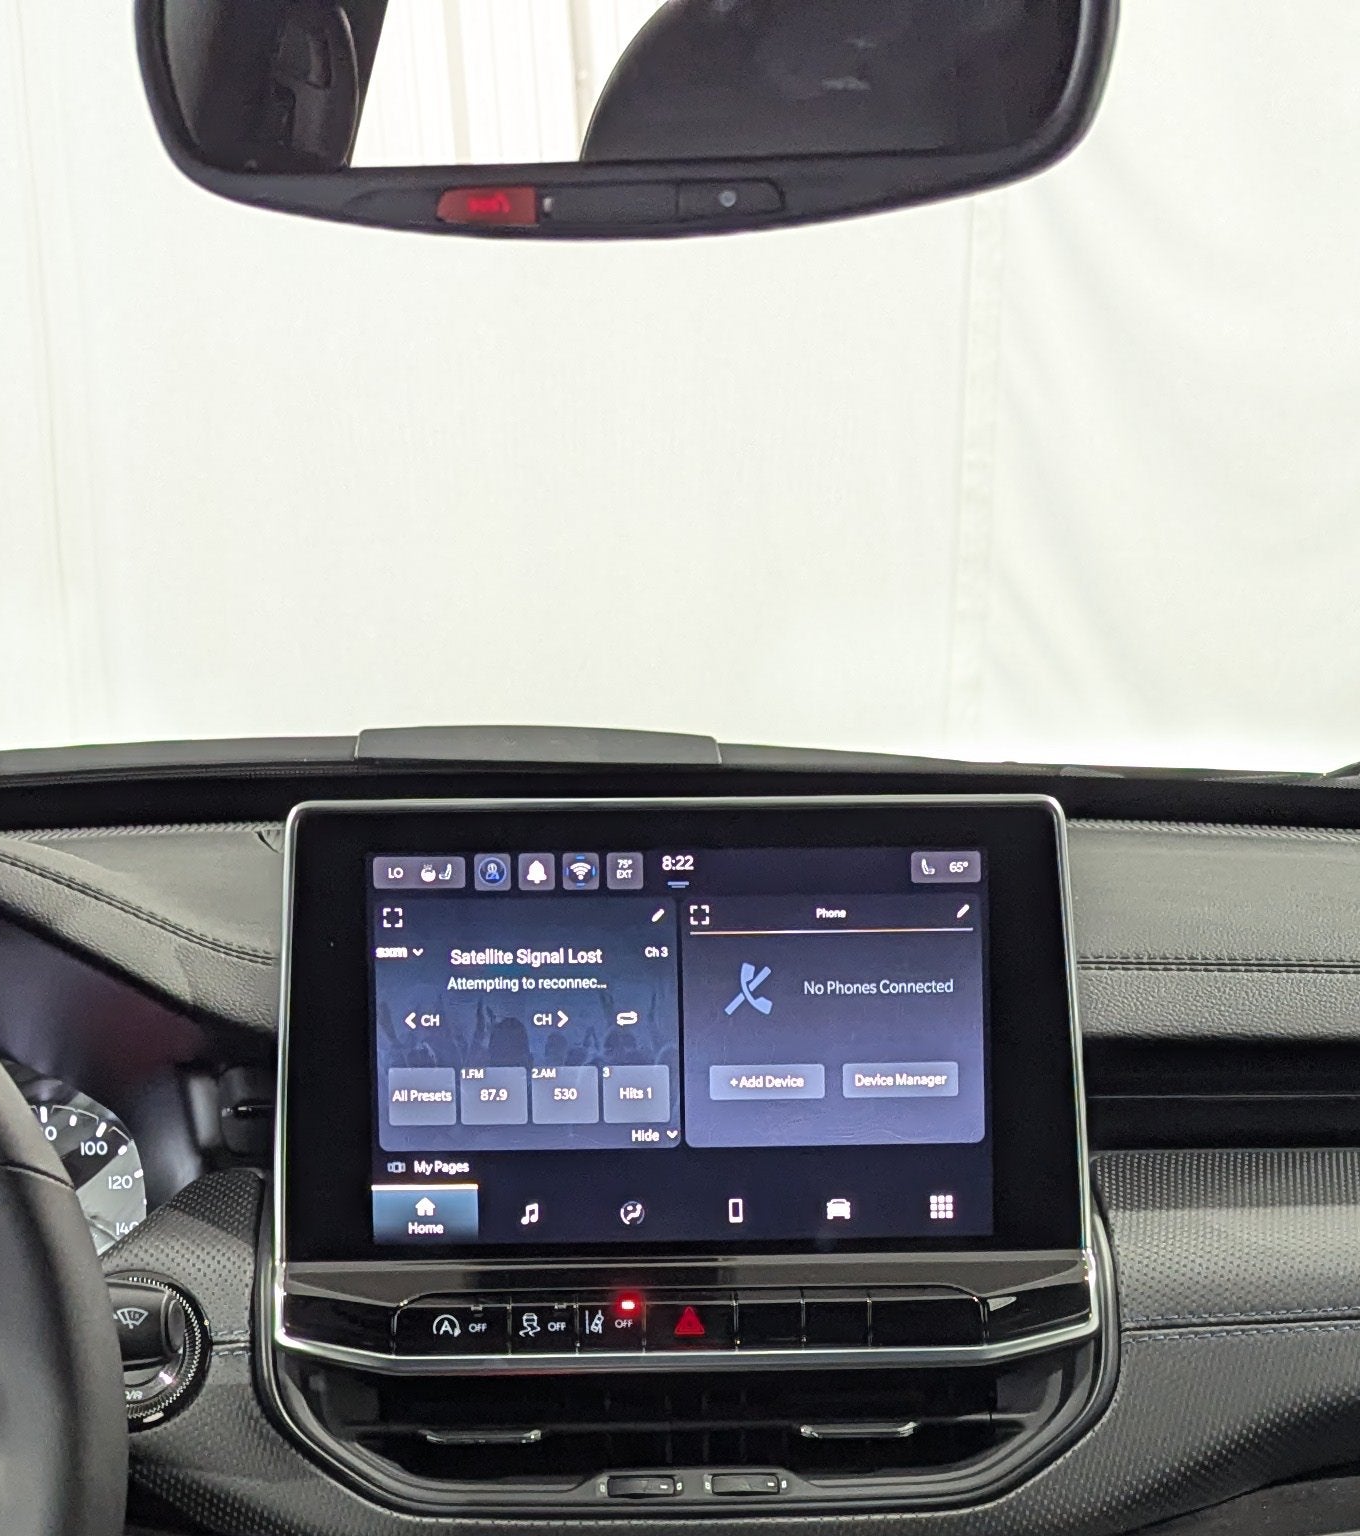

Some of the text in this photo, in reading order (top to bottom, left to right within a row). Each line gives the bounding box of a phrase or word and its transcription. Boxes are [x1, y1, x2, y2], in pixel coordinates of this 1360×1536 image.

[662, 855, 694, 870] 8:22
[388, 867, 404, 879] LO
[616, 870, 632, 878] EXT
[816, 907, 846, 919] Phone
[450, 948, 602, 968] Satellite Signal Lost
[644, 946, 668, 958] Ch 3
[447, 976, 518, 992] Attempting
[522, 977, 536, 990] to
[804, 979, 954, 996] No Phones Connected
[420, 1014, 440, 1026] CH
[533, 1014, 552, 1026] CH
[603, 1067, 610, 1078] 3
[766, 1075, 804, 1088] Device
[854, 1074, 948, 1089] Device Manager
[392, 1089, 452, 1102] All Presets
[480, 1088, 508, 1102] 87.9
[554, 1088, 578, 1100] 530
[620, 1087, 652, 1100] Hits 1
[631, 1129, 660, 1142] Hide
[80, 1140, 108, 1156] 100
[414, 1160, 470, 1176] My Pages
[108, 1175, 133, 1190] 120
[408, 1222, 444, 1235] Home
[468, 1322, 488, 1333] OFF
[548, 1322, 566, 1332] OFF
[614, 1318, 633, 1329] OFF
